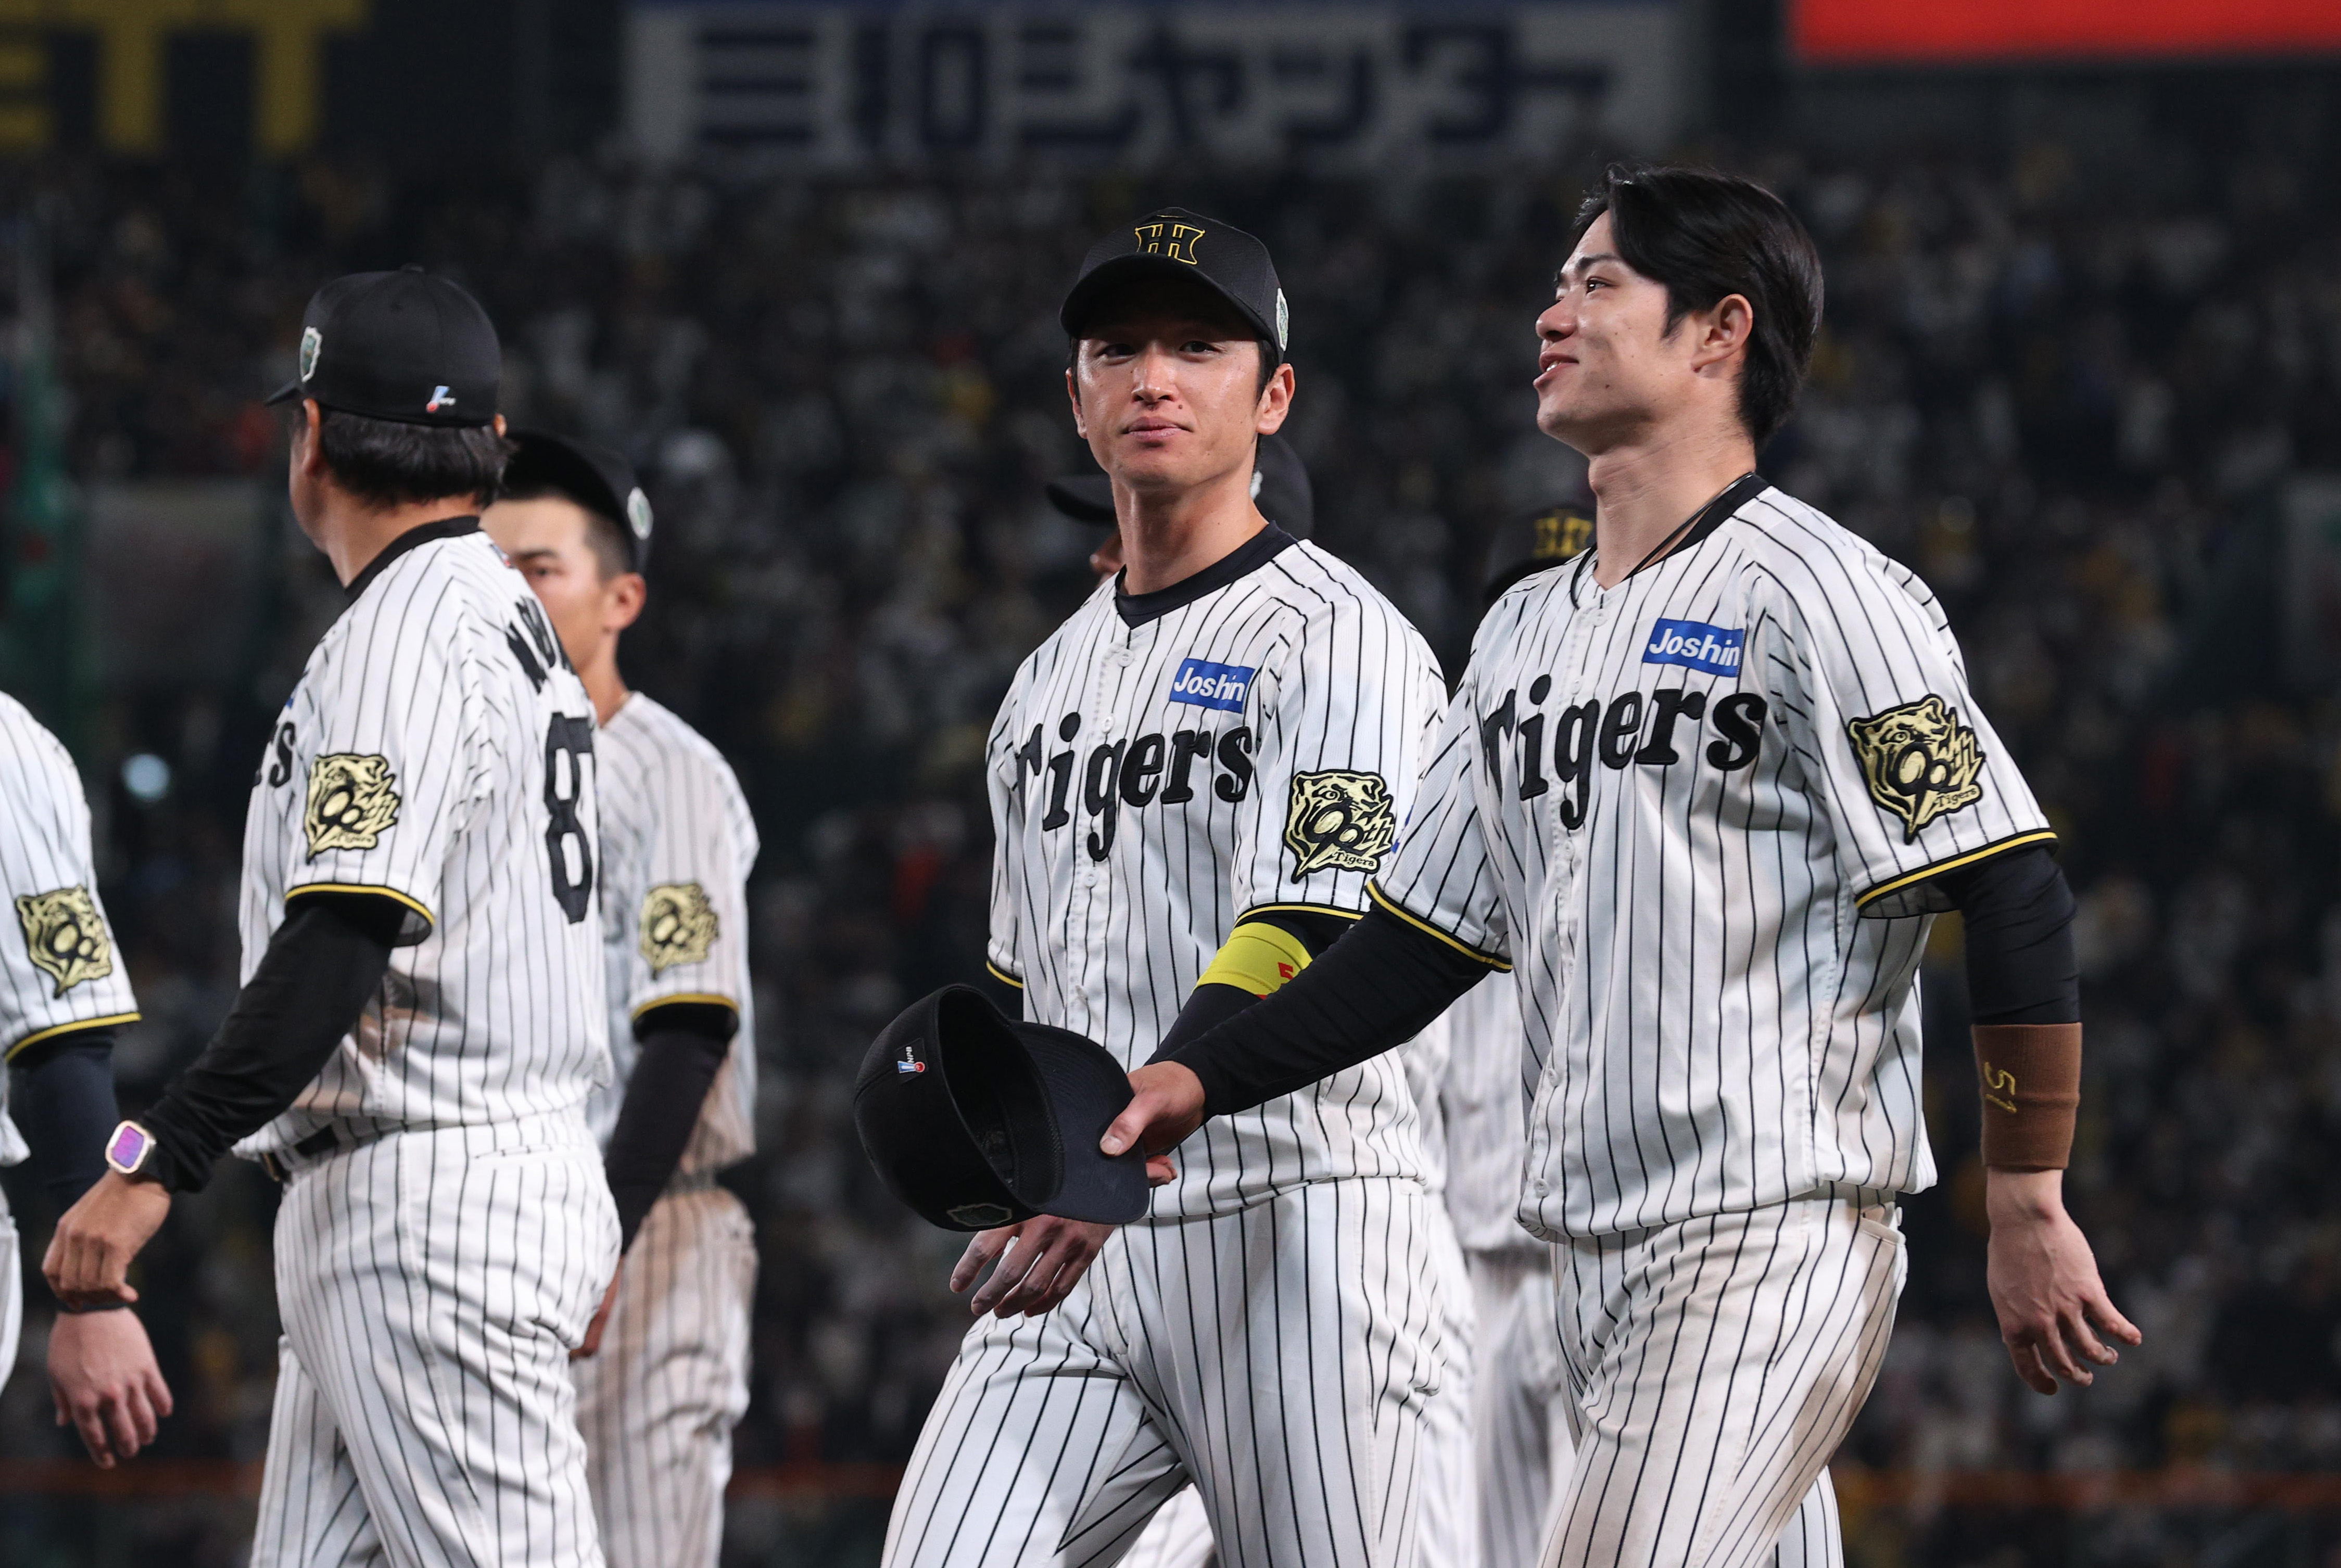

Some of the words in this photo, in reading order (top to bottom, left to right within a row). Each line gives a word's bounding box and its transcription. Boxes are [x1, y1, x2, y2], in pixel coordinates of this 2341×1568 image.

[1649, 628, 1740, 667] Joshin
[1173, 667, 1245, 702] Joshin
[1937, 787, 1978, 808] Tigers
[1334, 851, 1375, 868] Tigers
[1984, 1062, 2018, 1113] 51
